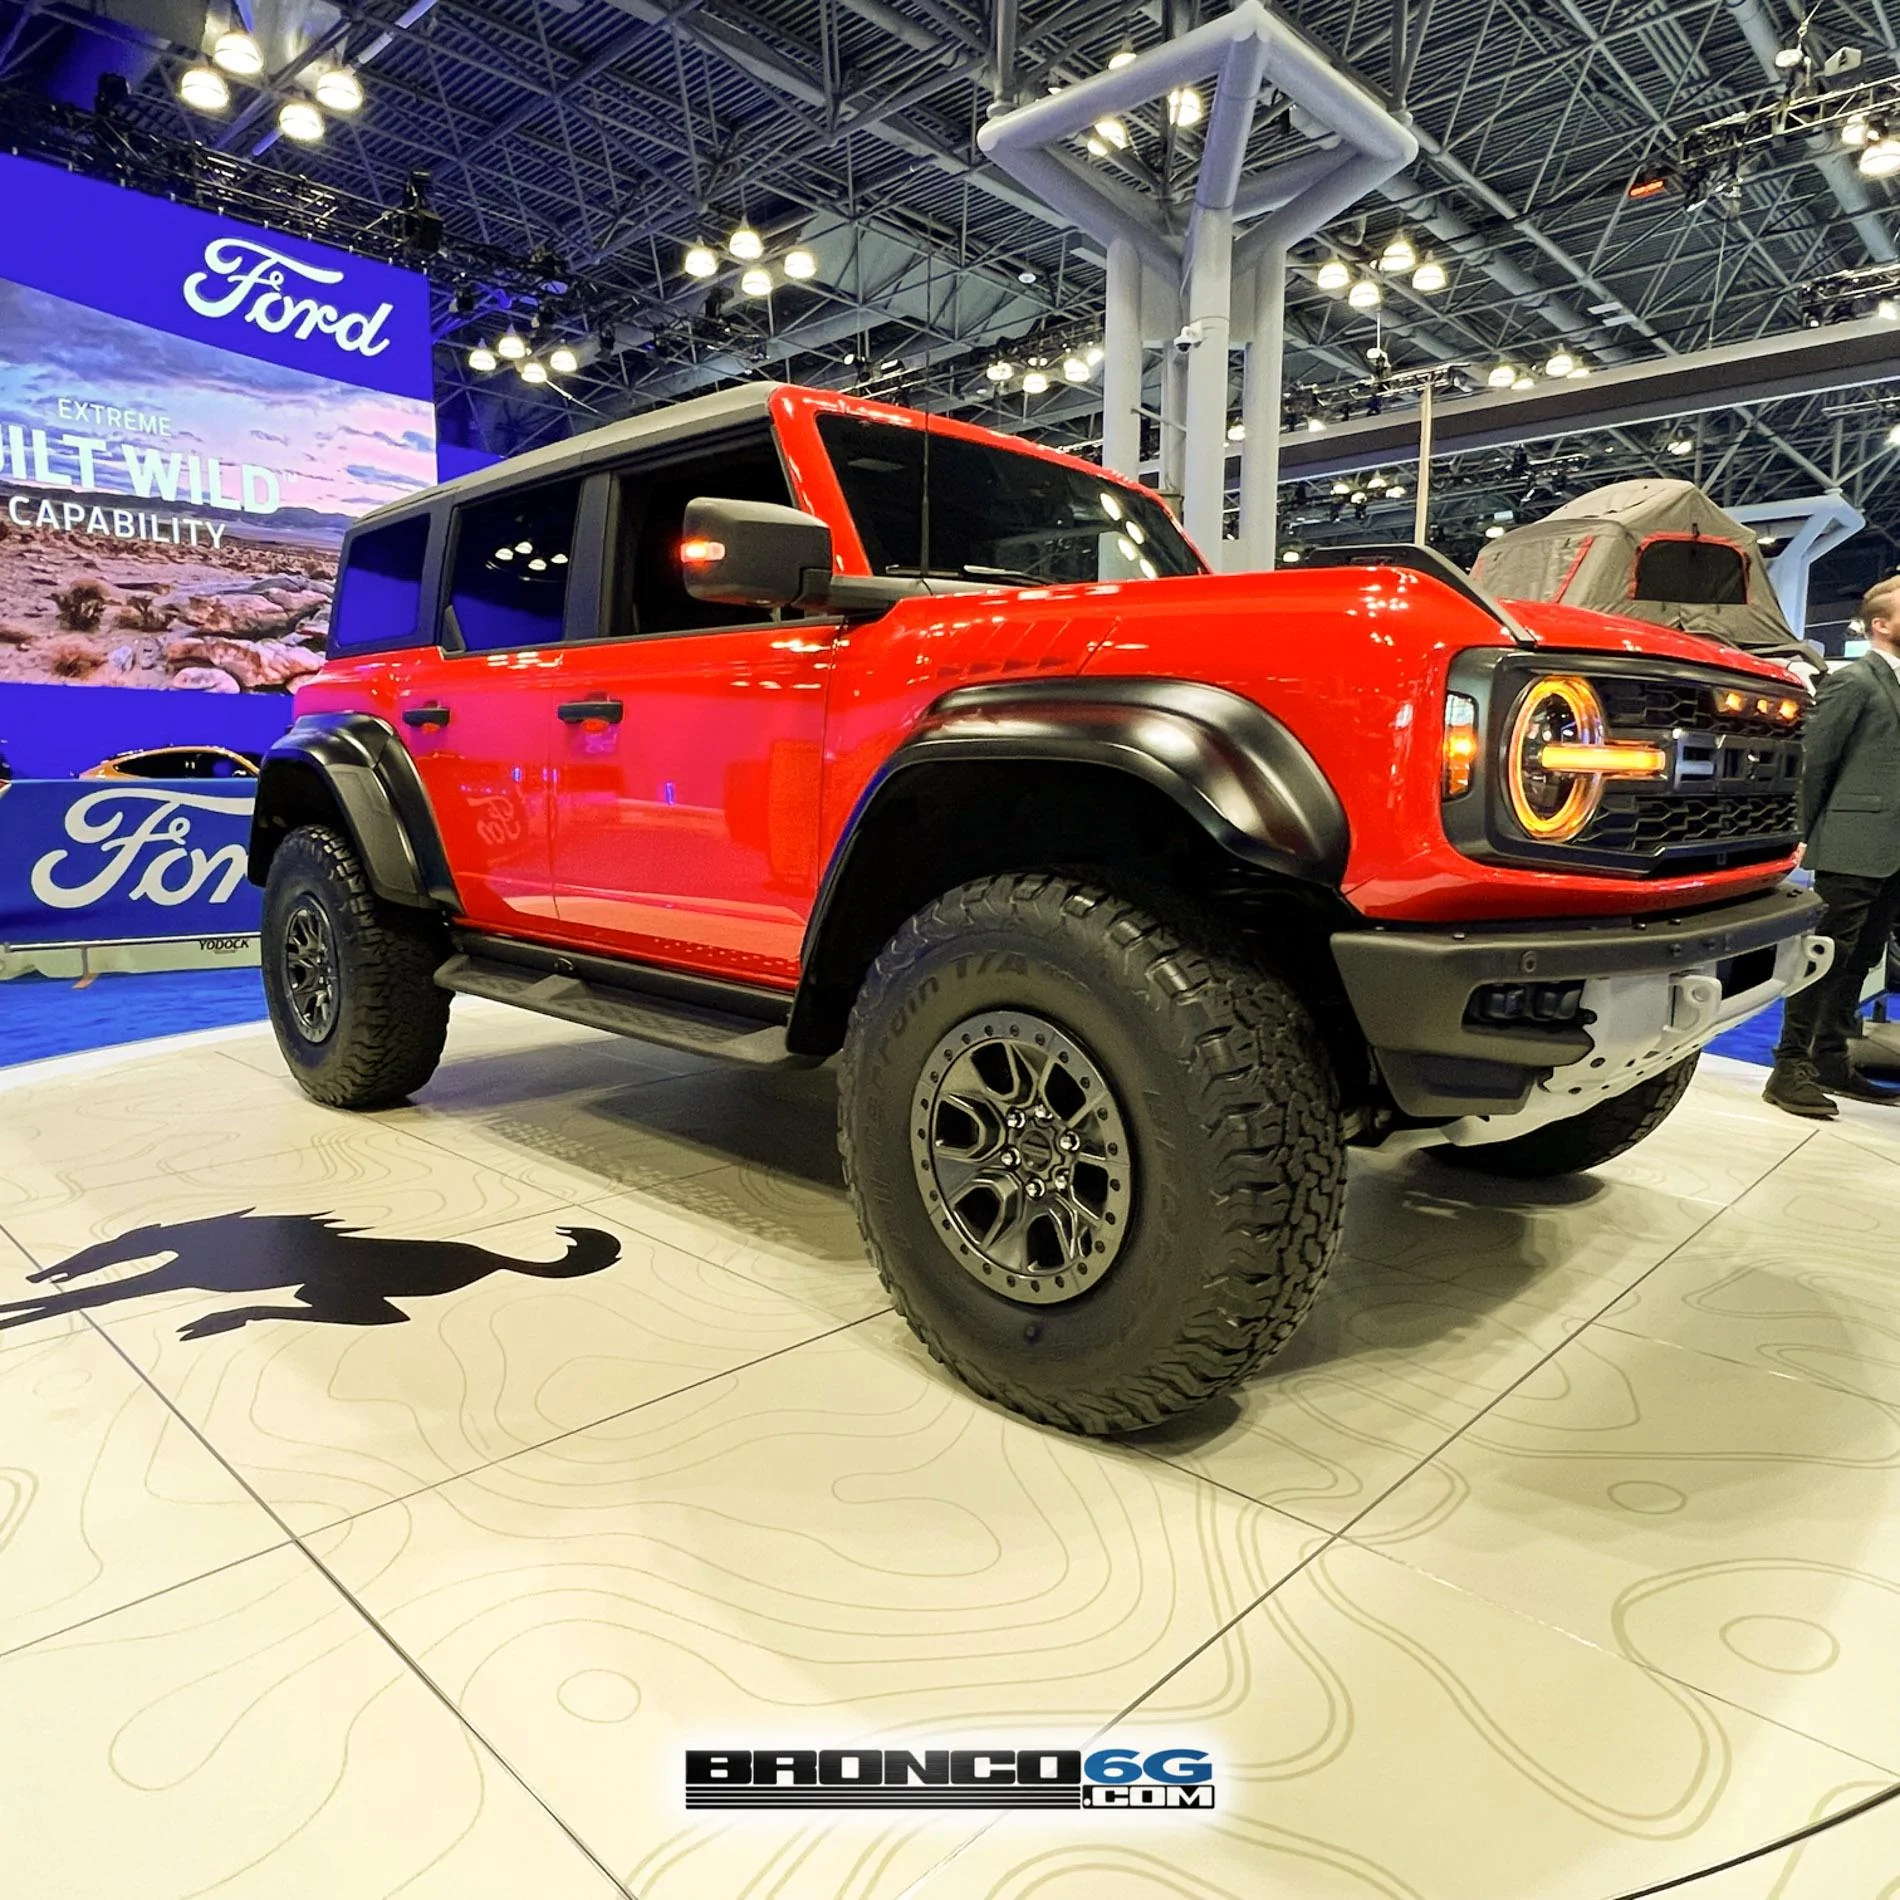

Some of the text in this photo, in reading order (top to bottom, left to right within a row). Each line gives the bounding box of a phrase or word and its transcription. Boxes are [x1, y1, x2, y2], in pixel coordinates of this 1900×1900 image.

[183, 238, 394, 357] Ford
[58, 398, 172, 437] EXTREME
[0, 423, 107, 489] ILT
[8, 495, 227, 549] CAPABILITY
[199, 938, 250, 951] YODOCK
